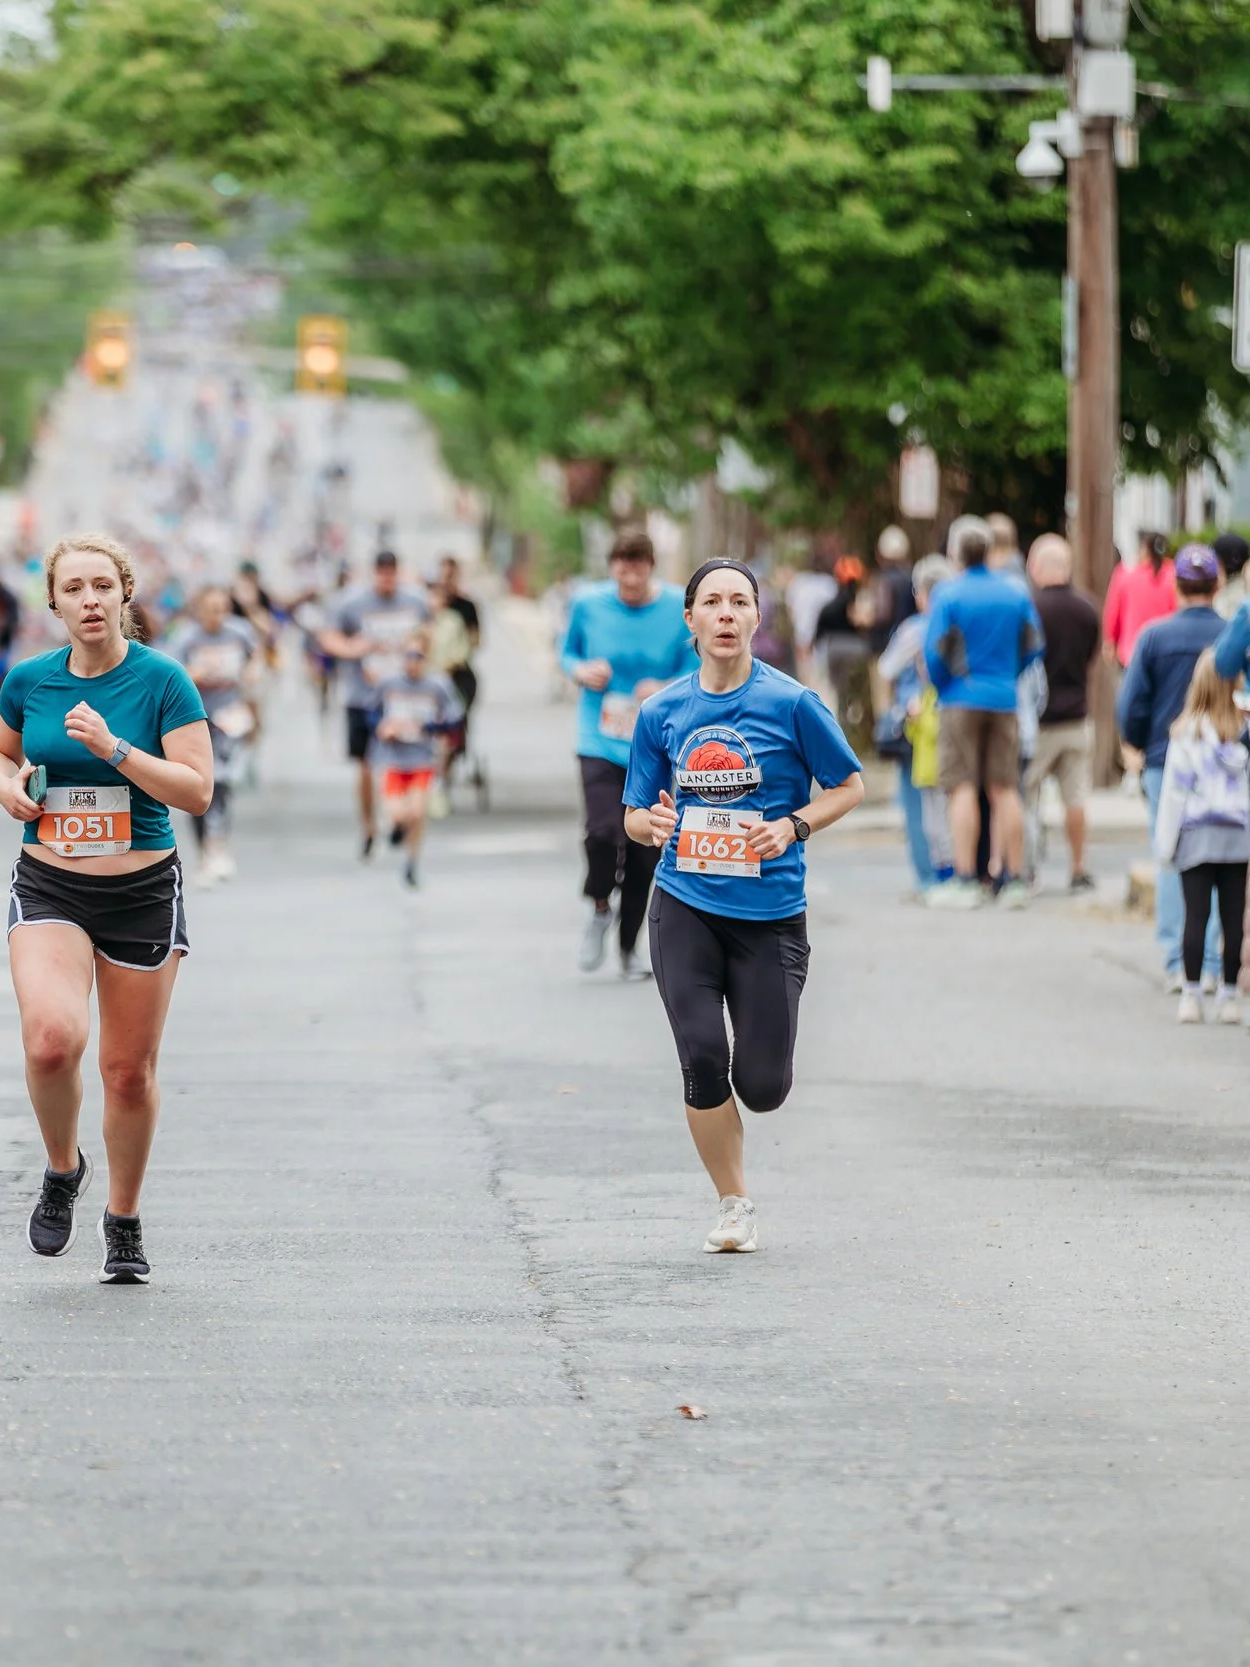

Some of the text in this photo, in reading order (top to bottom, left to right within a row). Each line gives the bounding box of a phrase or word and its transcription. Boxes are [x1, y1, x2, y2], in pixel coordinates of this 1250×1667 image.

[680, 772, 754, 783] LANCASTER
[54, 816, 113, 839] 1051
[690, 834, 747, 860] 1662
